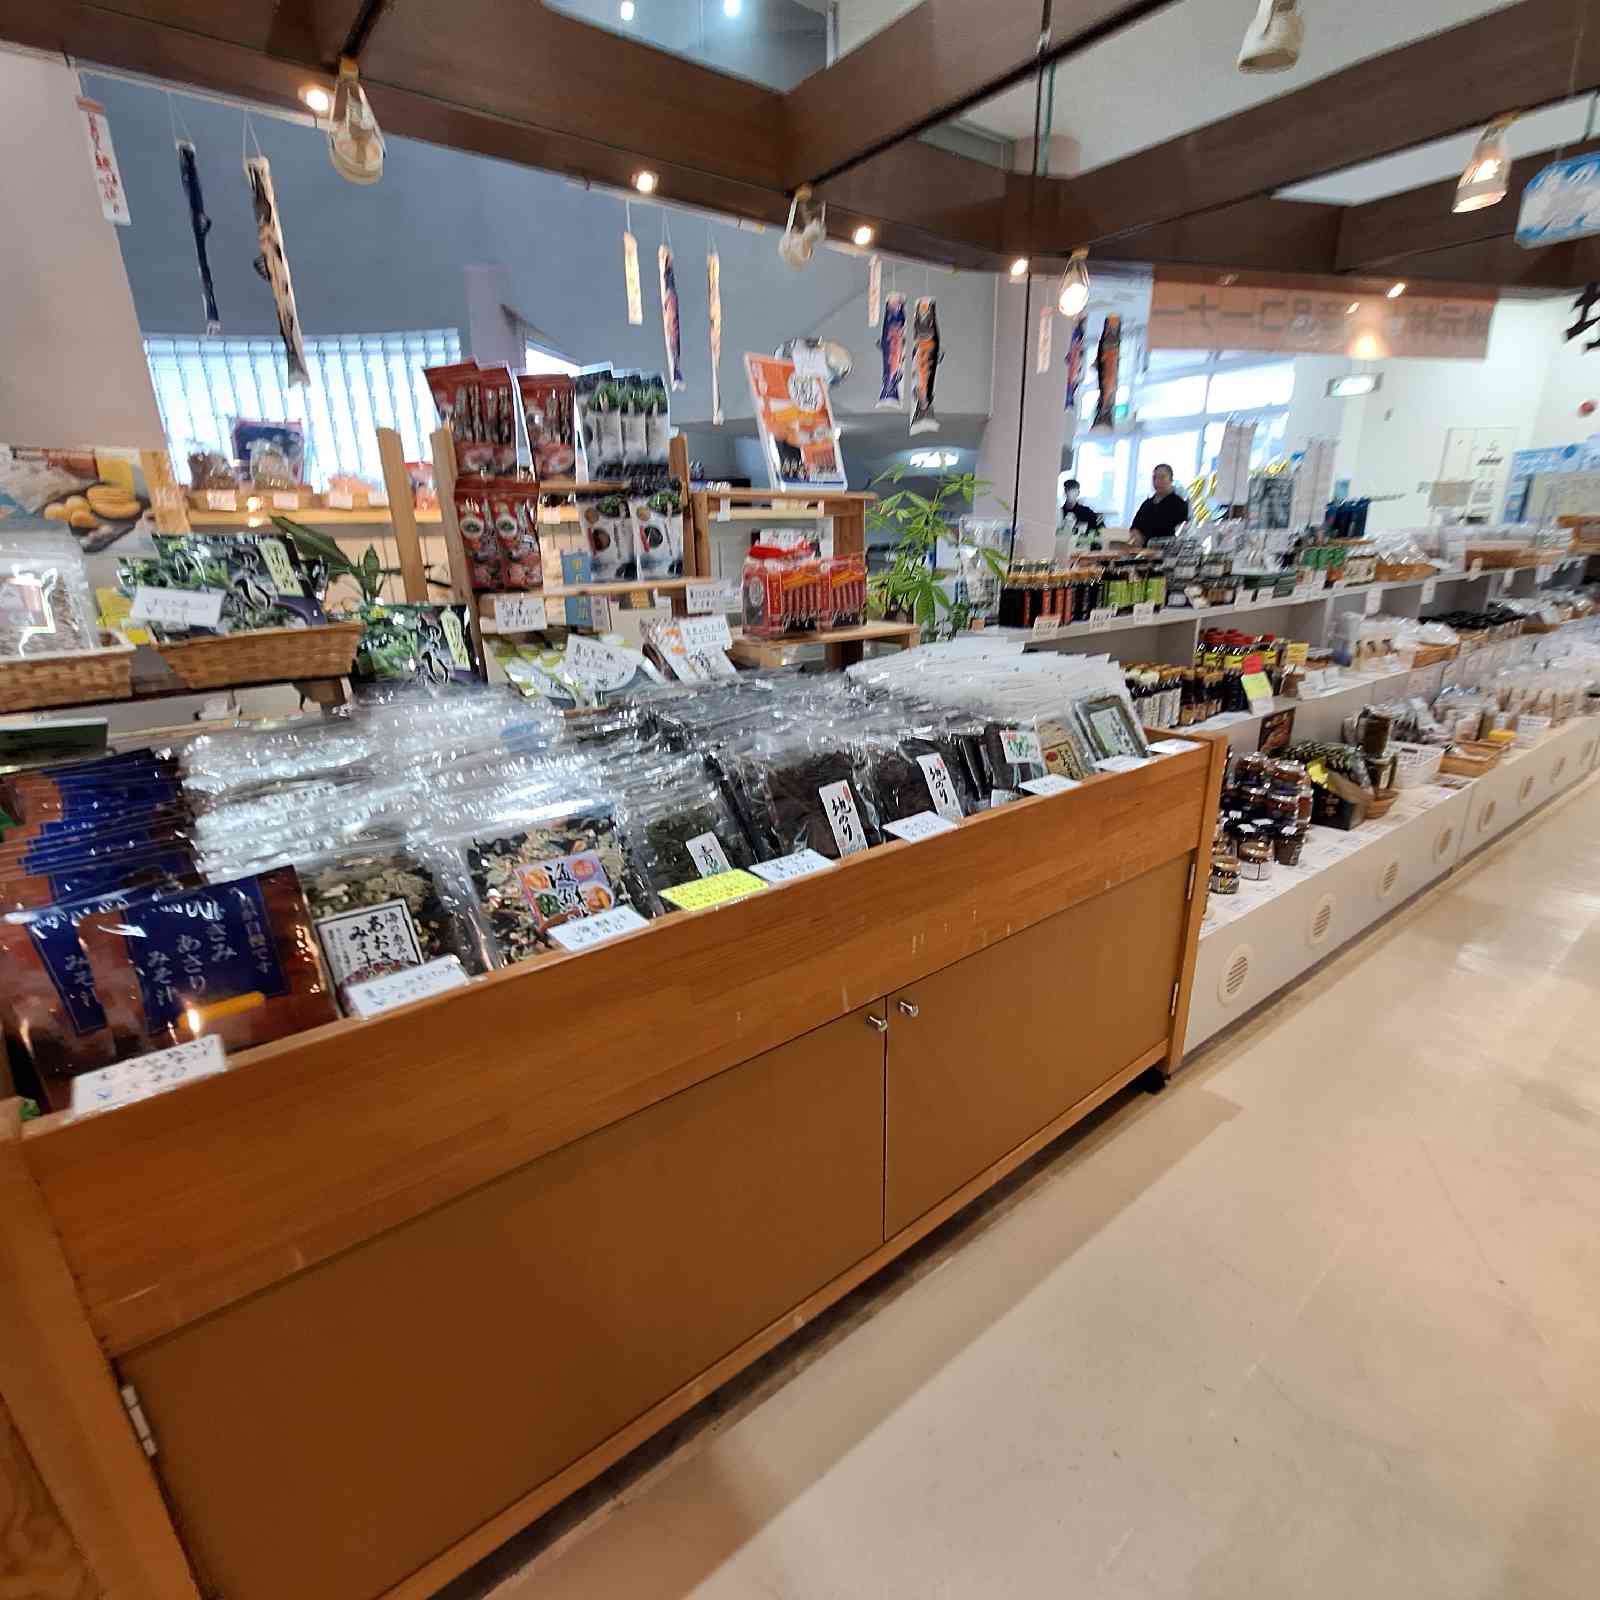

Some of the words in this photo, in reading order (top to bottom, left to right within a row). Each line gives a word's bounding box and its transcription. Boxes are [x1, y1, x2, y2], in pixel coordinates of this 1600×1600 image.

[929, 766, 949, 804] 地のり
[831, 796, 853, 842] 地のり
[147, 950, 178, 1007] みそ汁
[175, 933, 208, 992] あさり
